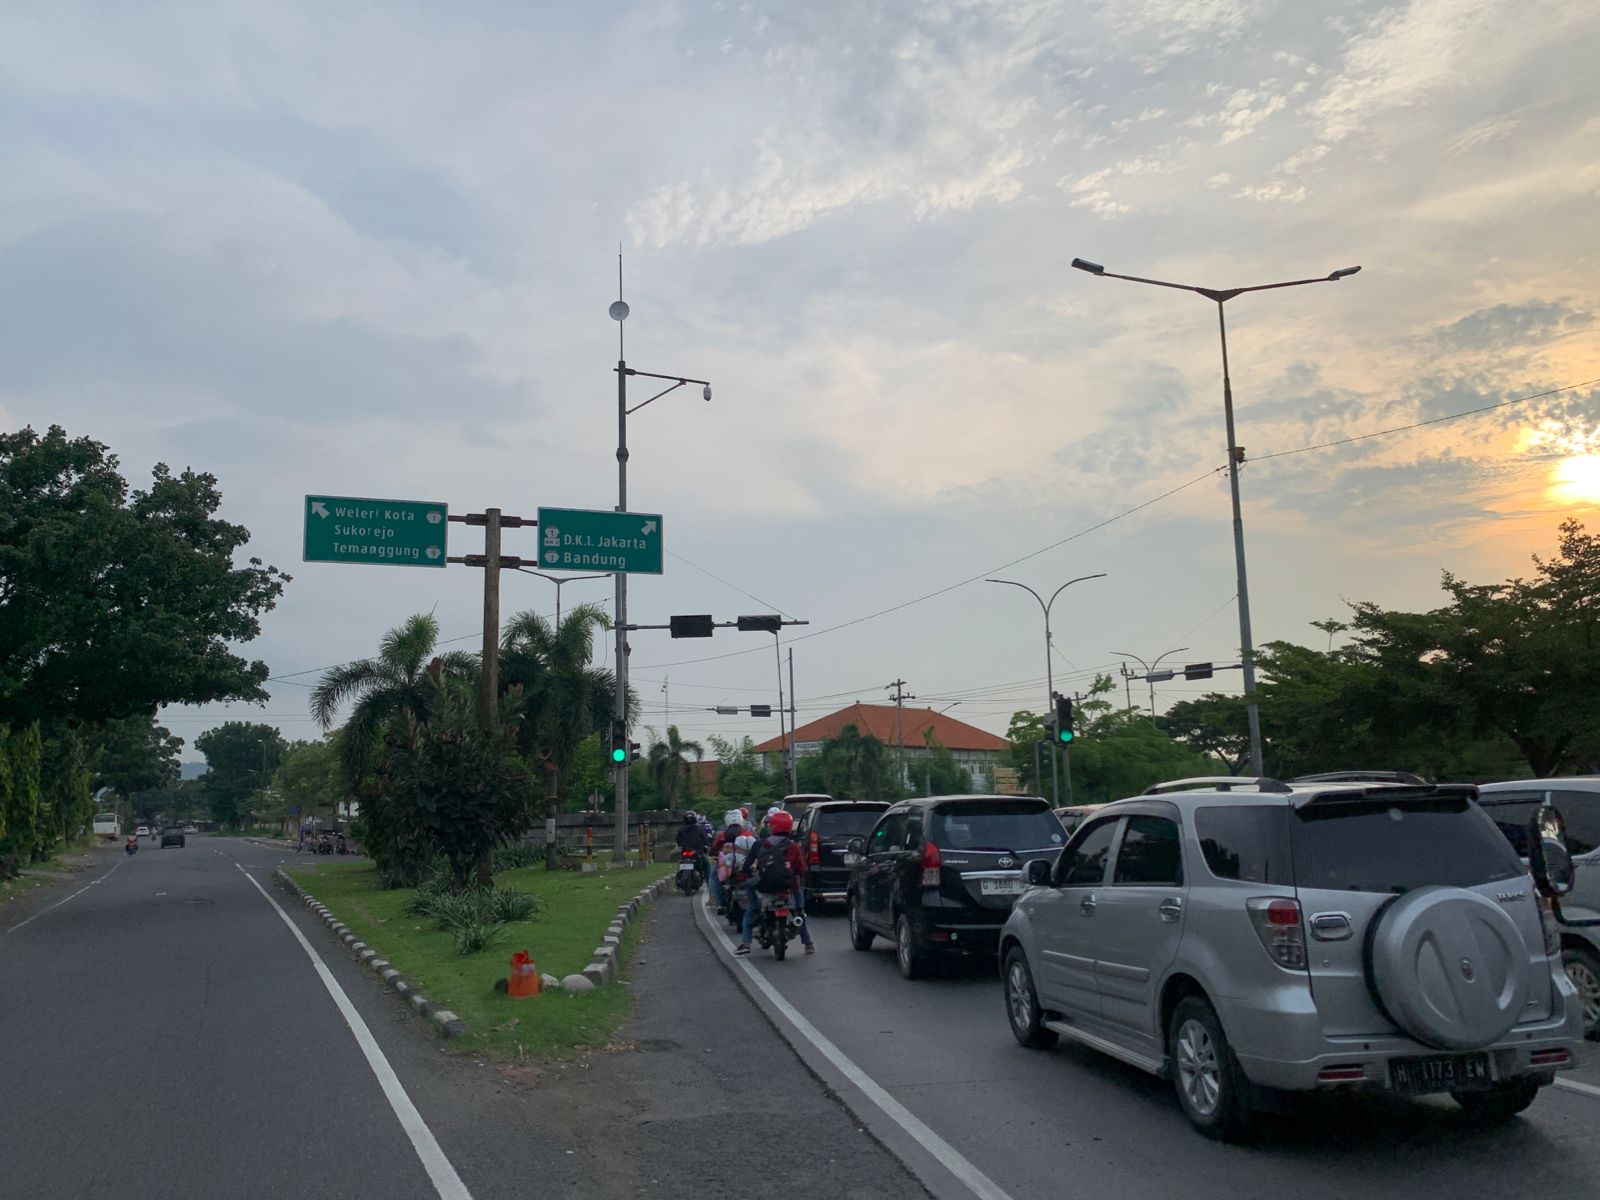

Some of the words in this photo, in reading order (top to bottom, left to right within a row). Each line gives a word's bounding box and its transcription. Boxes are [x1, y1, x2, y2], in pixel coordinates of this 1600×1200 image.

[335, 507, 379, 519] Weleri
[384, 510, 415, 521] Kota
[334, 525, 395, 539] Sukorejo
[598, 536, 647, 549] Jakarta
[333, 543, 420, 559] Temanggung
[564, 552, 626, 569] Bandung
